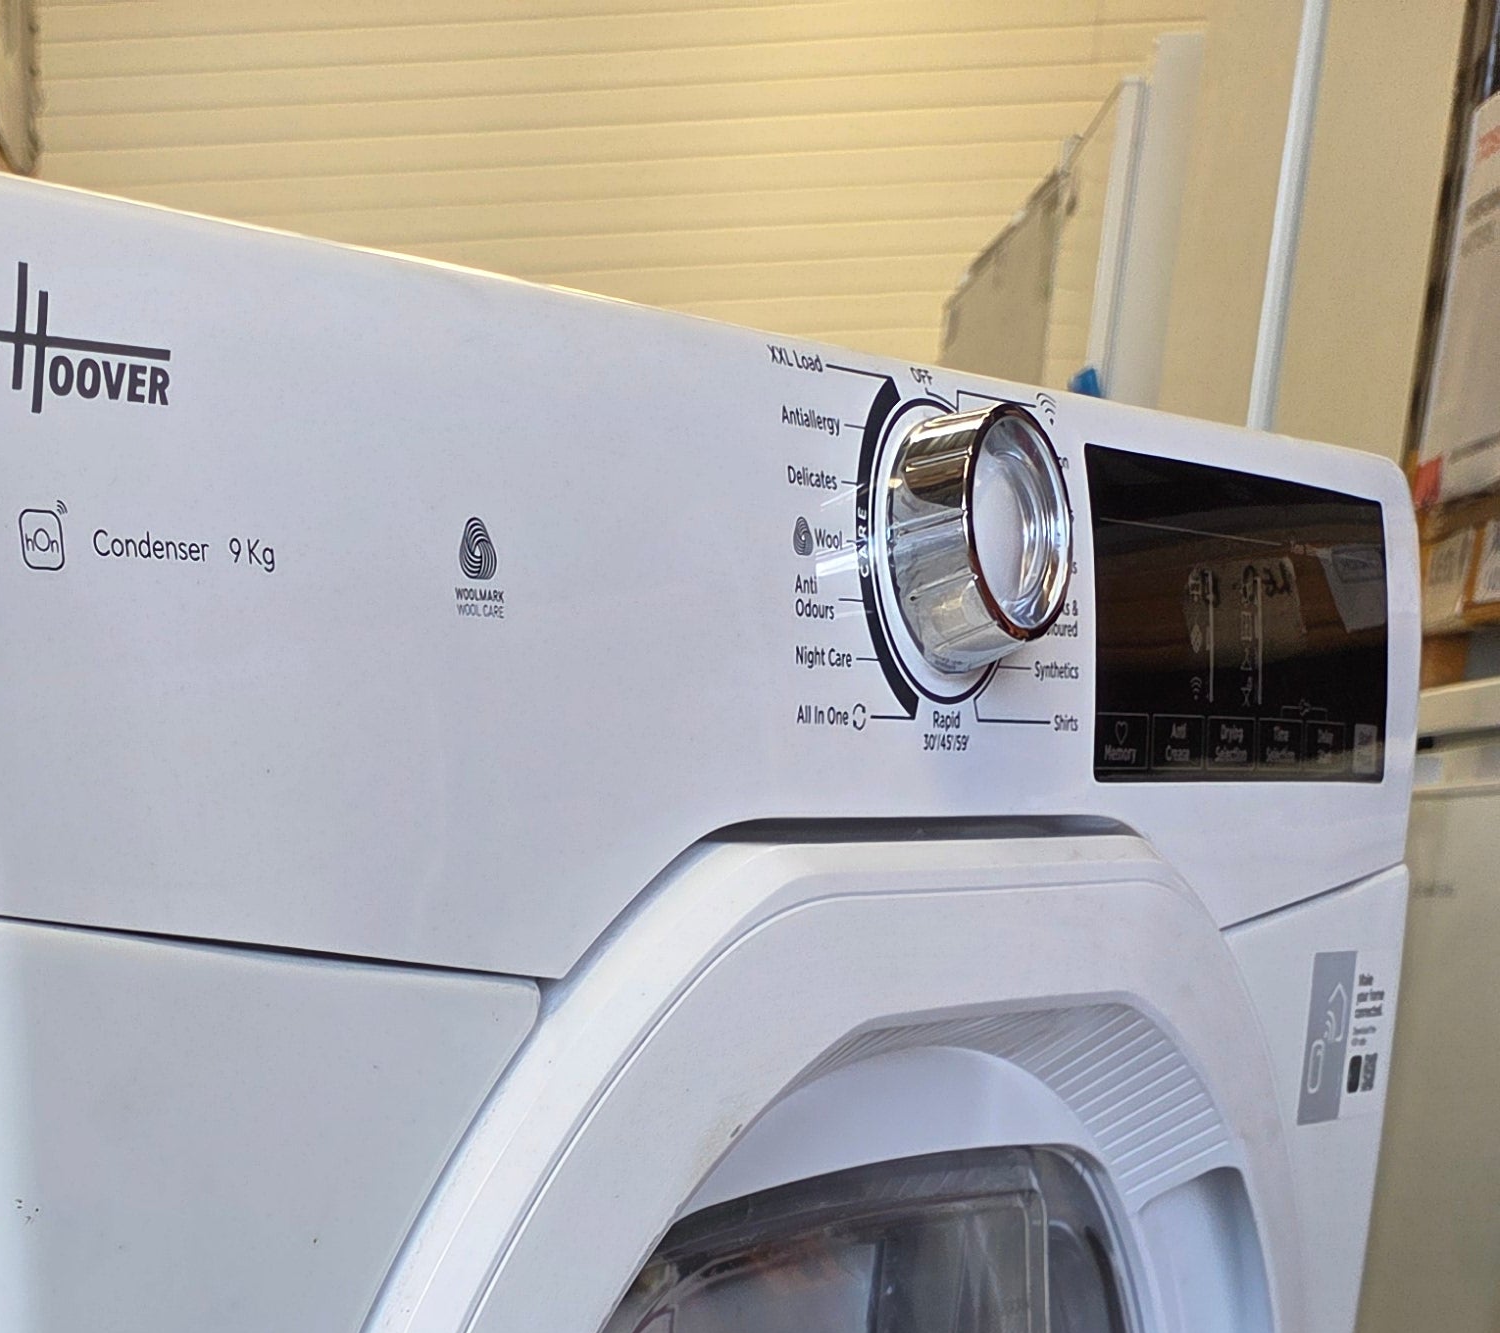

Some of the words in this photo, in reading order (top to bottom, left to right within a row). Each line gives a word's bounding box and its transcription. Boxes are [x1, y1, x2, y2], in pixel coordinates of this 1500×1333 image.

[766, 344, 794, 367] XXL
[793, 349, 824, 373] Load
[909, 366, 934, 386] OFF
[781, 404, 841, 437] Antiallergy
[787, 464, 839, 491] Delicates
[814, 527, 843, 551] Wool
[92, 528, 210, 563] Condenser
[228, 536, 242, 564] 9
[246, 538, 276, 573] Kg
[454, 586, 505, 604] WOOLMARK
[794, 573, 818, 595] Anti
[456, 603, 482, 617] WOOL
[482, 603, 505, 619] CARE
[795, 598, 835, 620] Odours
[795, 644, 826, 669] Night
[827, 647, 853, 668] Care
[1034, 660, 1080, 681] Synthetics
[796, 704, 812, 724] All
[813, 705, 825, 725] In
[826, 705, 850, 726] One
[932, 710, 961, 731] Rapid
[1053, 714, 1079, 732] Shirts
[1103, 744, 1137, 764] Memory
